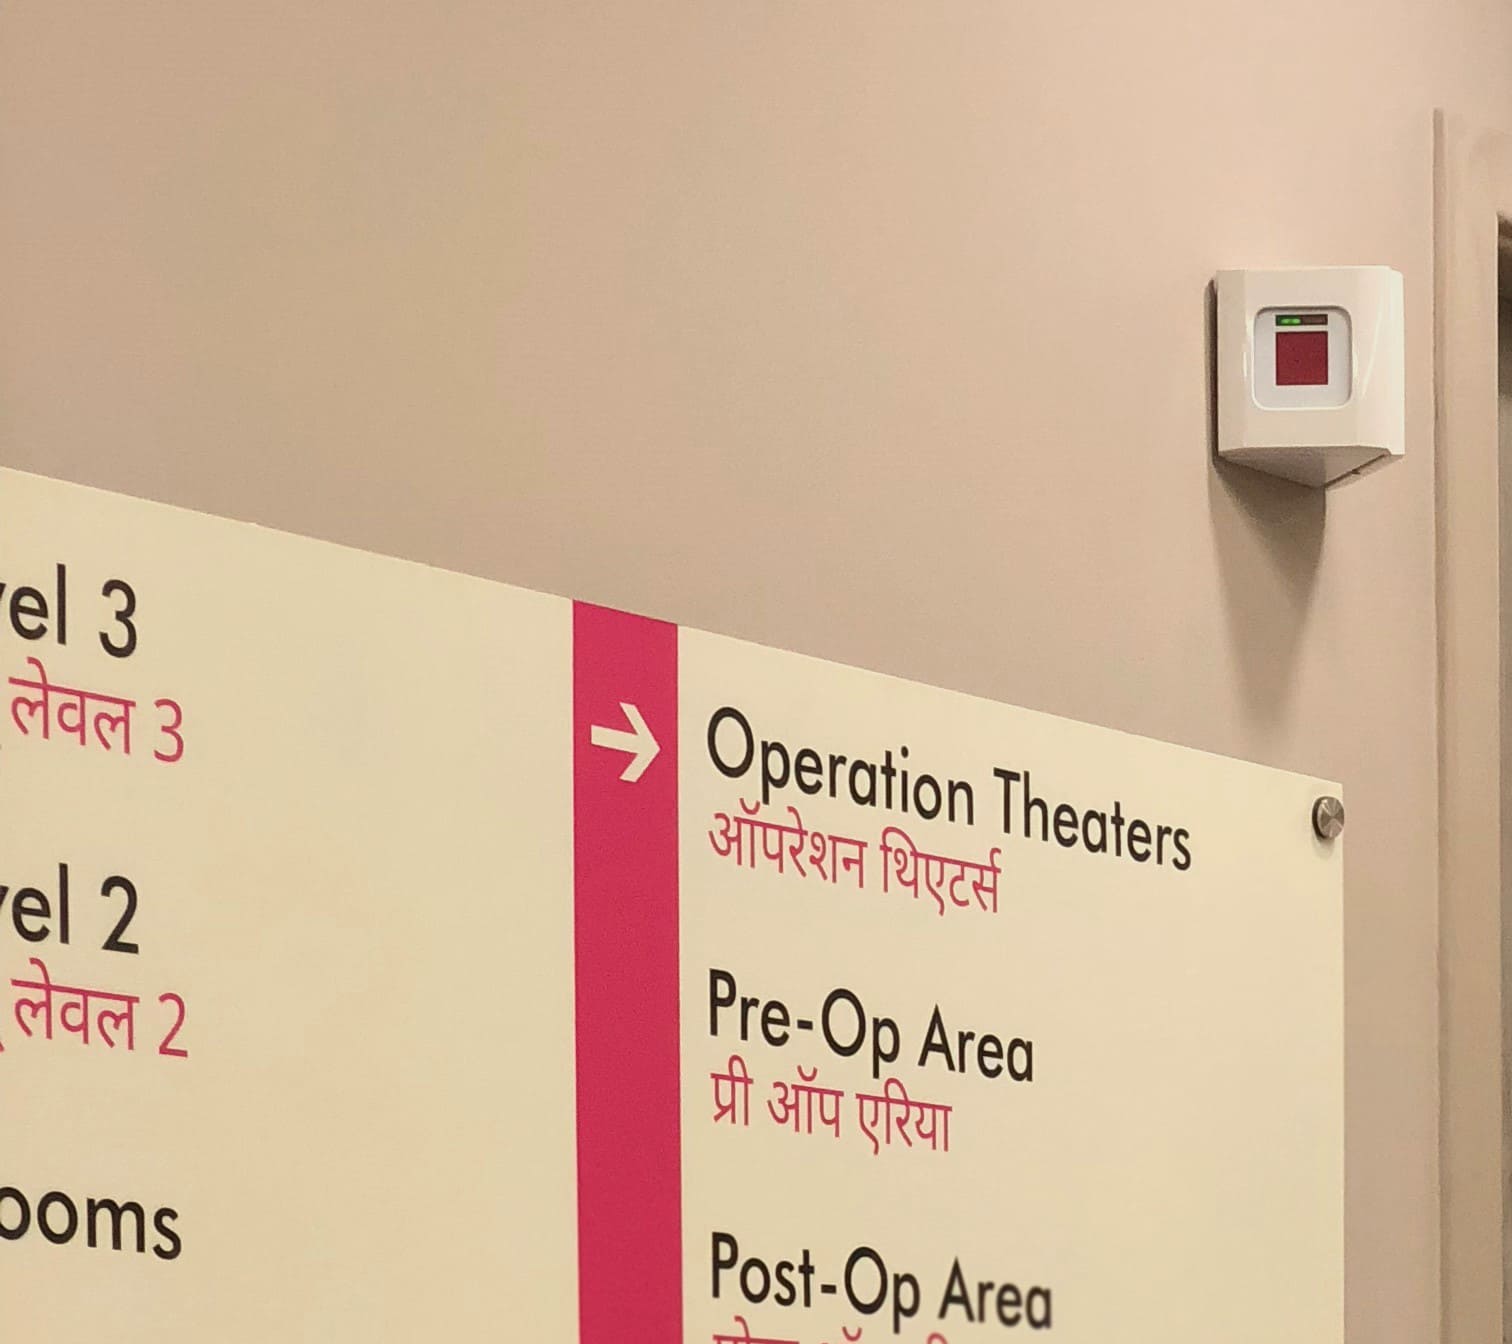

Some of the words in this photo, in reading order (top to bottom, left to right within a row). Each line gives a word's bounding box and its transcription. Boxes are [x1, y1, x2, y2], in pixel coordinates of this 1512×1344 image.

[0, 563, 67, 646] el
[99, 579, 137, 659] 3
[8, 656, 136, 755] लेवल
[153, 697, 184, 764] 3
[707, 706, 974, 826] Operation
[993, 767, 1191, 871] Theaters
[0, 862, 70, 945] el
[101, 875, 139, 955] 2
[708, 798, 868, 889] ऑपरेशन
[880, 825, 1001, 916] थिएटर्स
[10, 956, 140, 1052] लेवल
[158, 992, 189, 1059] 2
[709, 968, 901, 1080] Pre-Op
[917, 1004, 1034, 1082] Area
[710, 1054, 753, 1126] प्री
[767, 1065, 845, 1138] ऑप
[855, 1077, 953, 1155] एरिया
[0, 1186, 182, 1261] ooms
[711, 1231, 921, 1335] Post-Op
[938, 1257, 1053, 1330] Area
